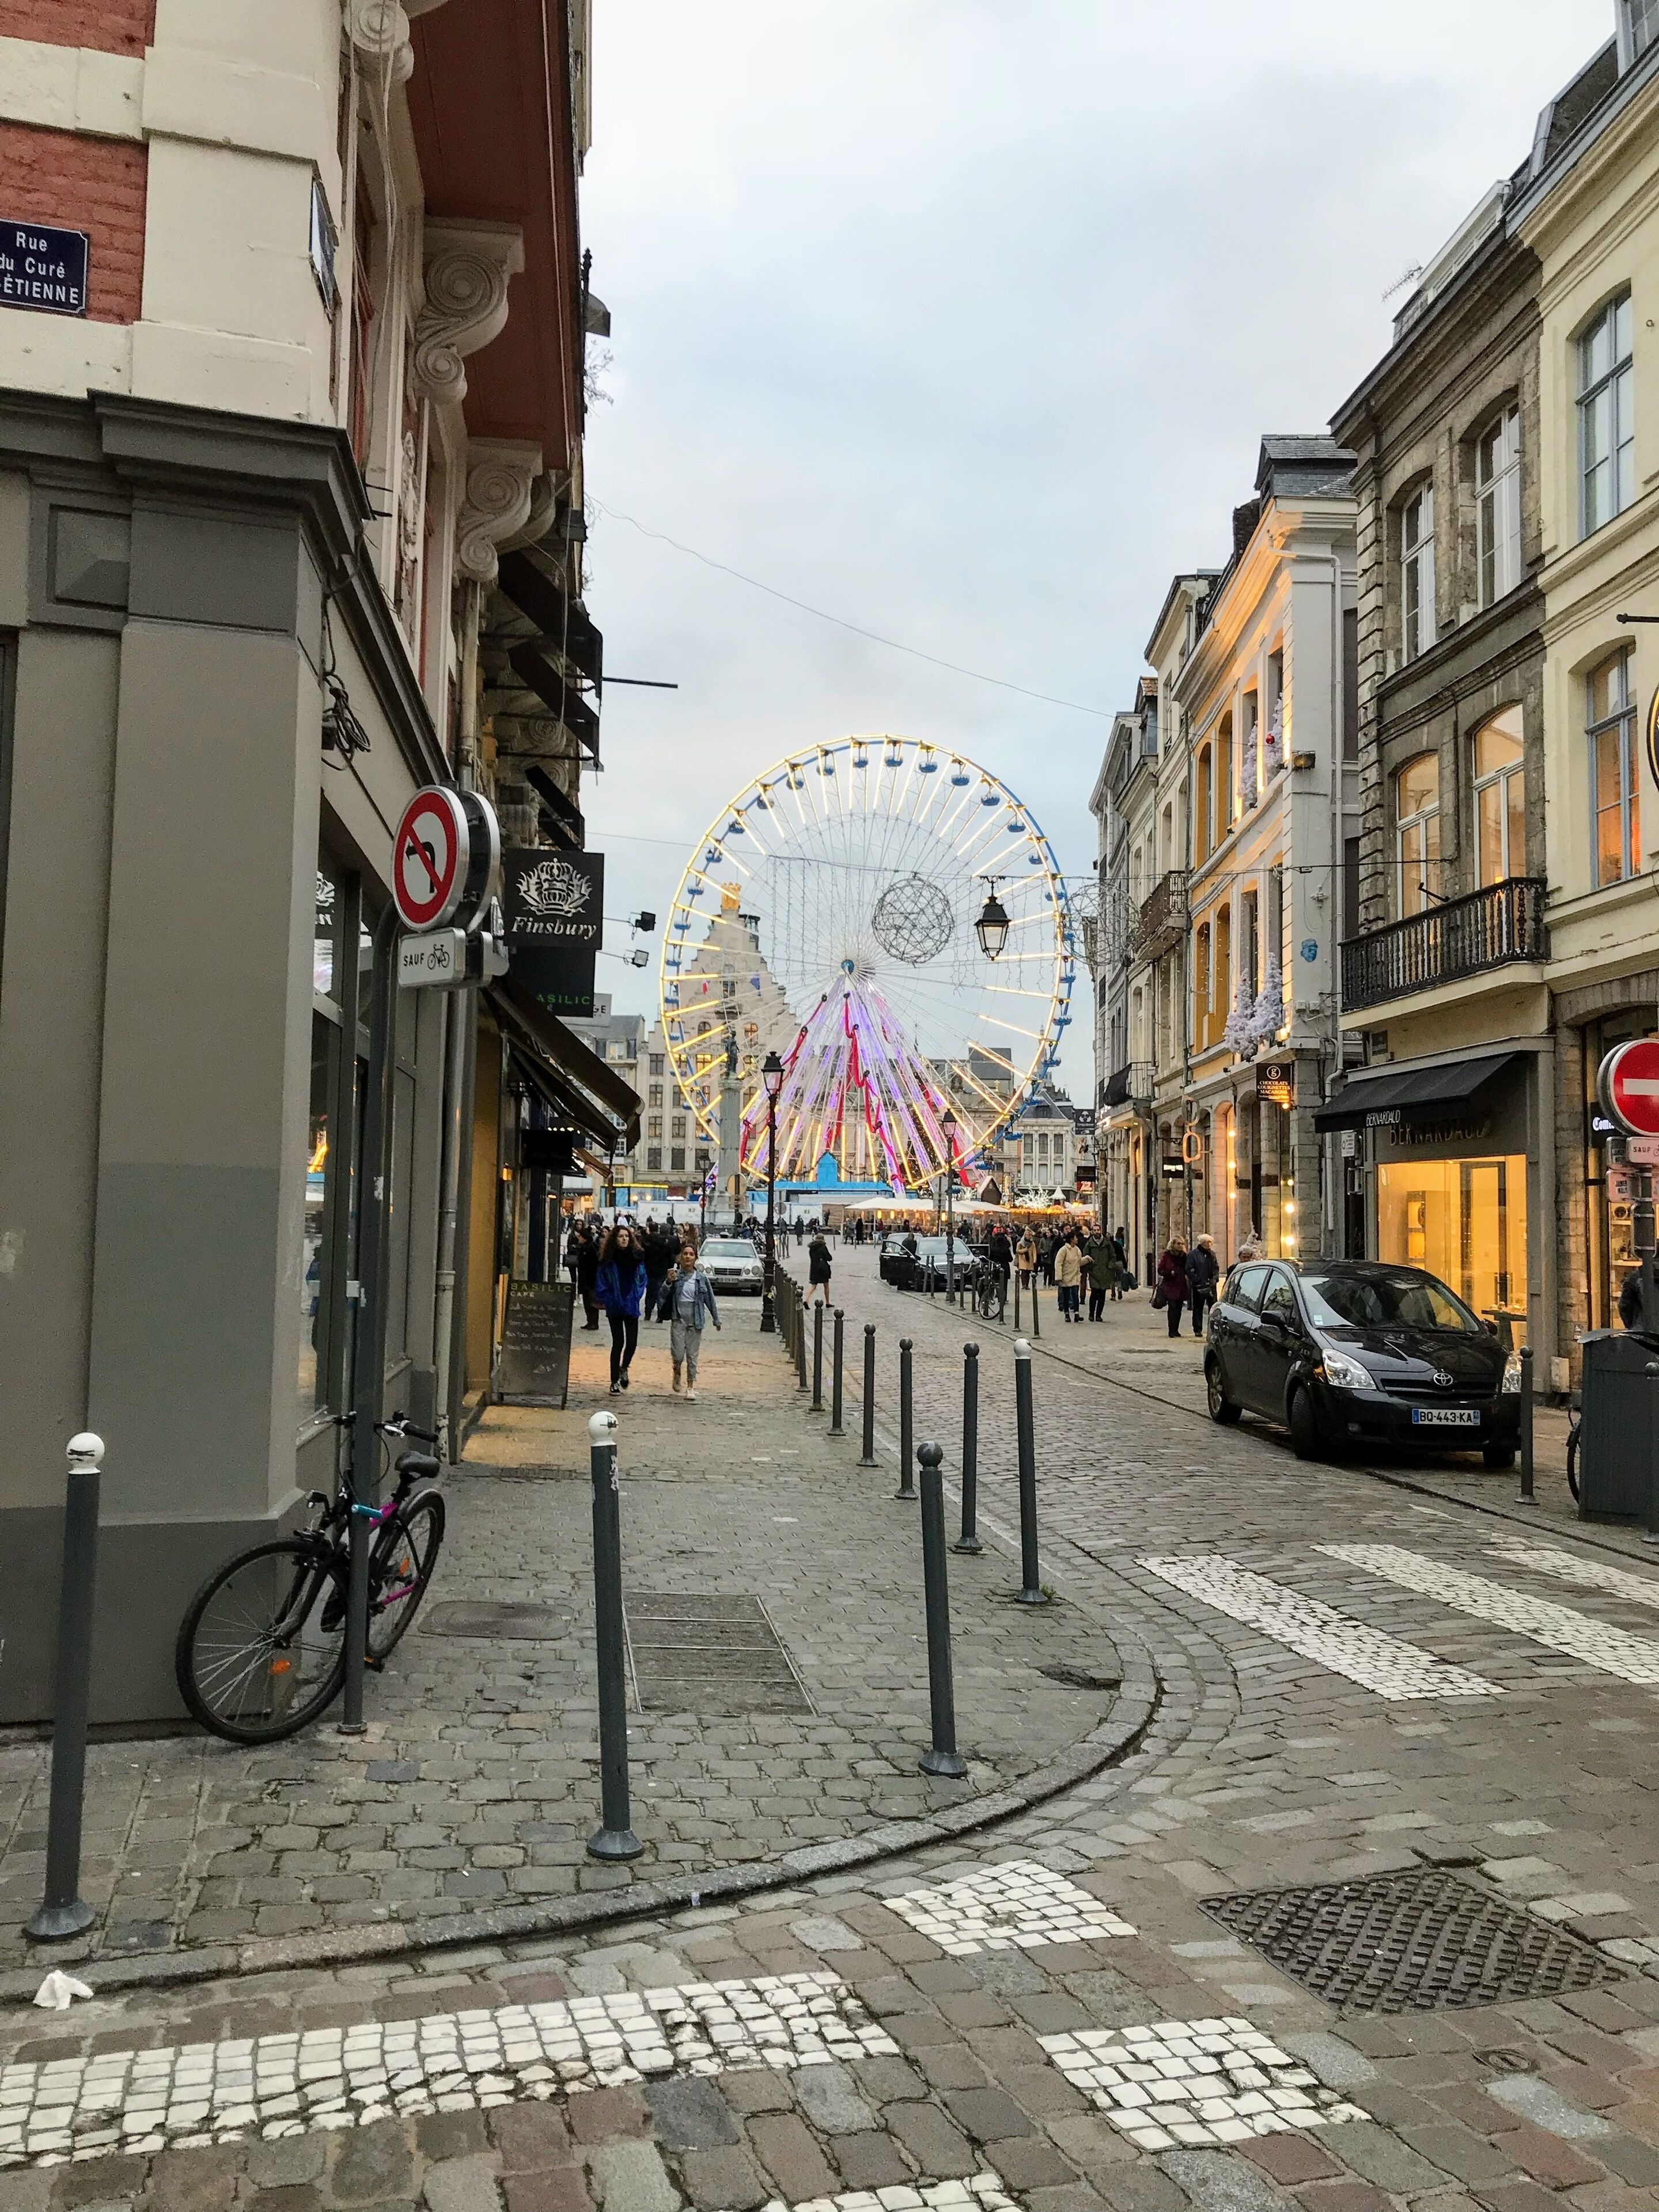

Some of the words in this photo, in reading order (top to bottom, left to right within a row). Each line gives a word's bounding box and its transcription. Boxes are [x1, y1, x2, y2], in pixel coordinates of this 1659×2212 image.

[16, 230, 47, 252] Rue
[0, 253, 14, 271] du
[25, 256, 66, 279] Curé
[511, 916, 597, 940] Finsbury
[403, 953, 425, 967] SAUF
[536, 994, 590, 1005] ASILIC
[1366, 1109, 1400, 1127] BERNARDAUD
[510, 1283, 571, 1293] BASILIC
[1419, 1411, 1472, 1423] BQ-443-KA
